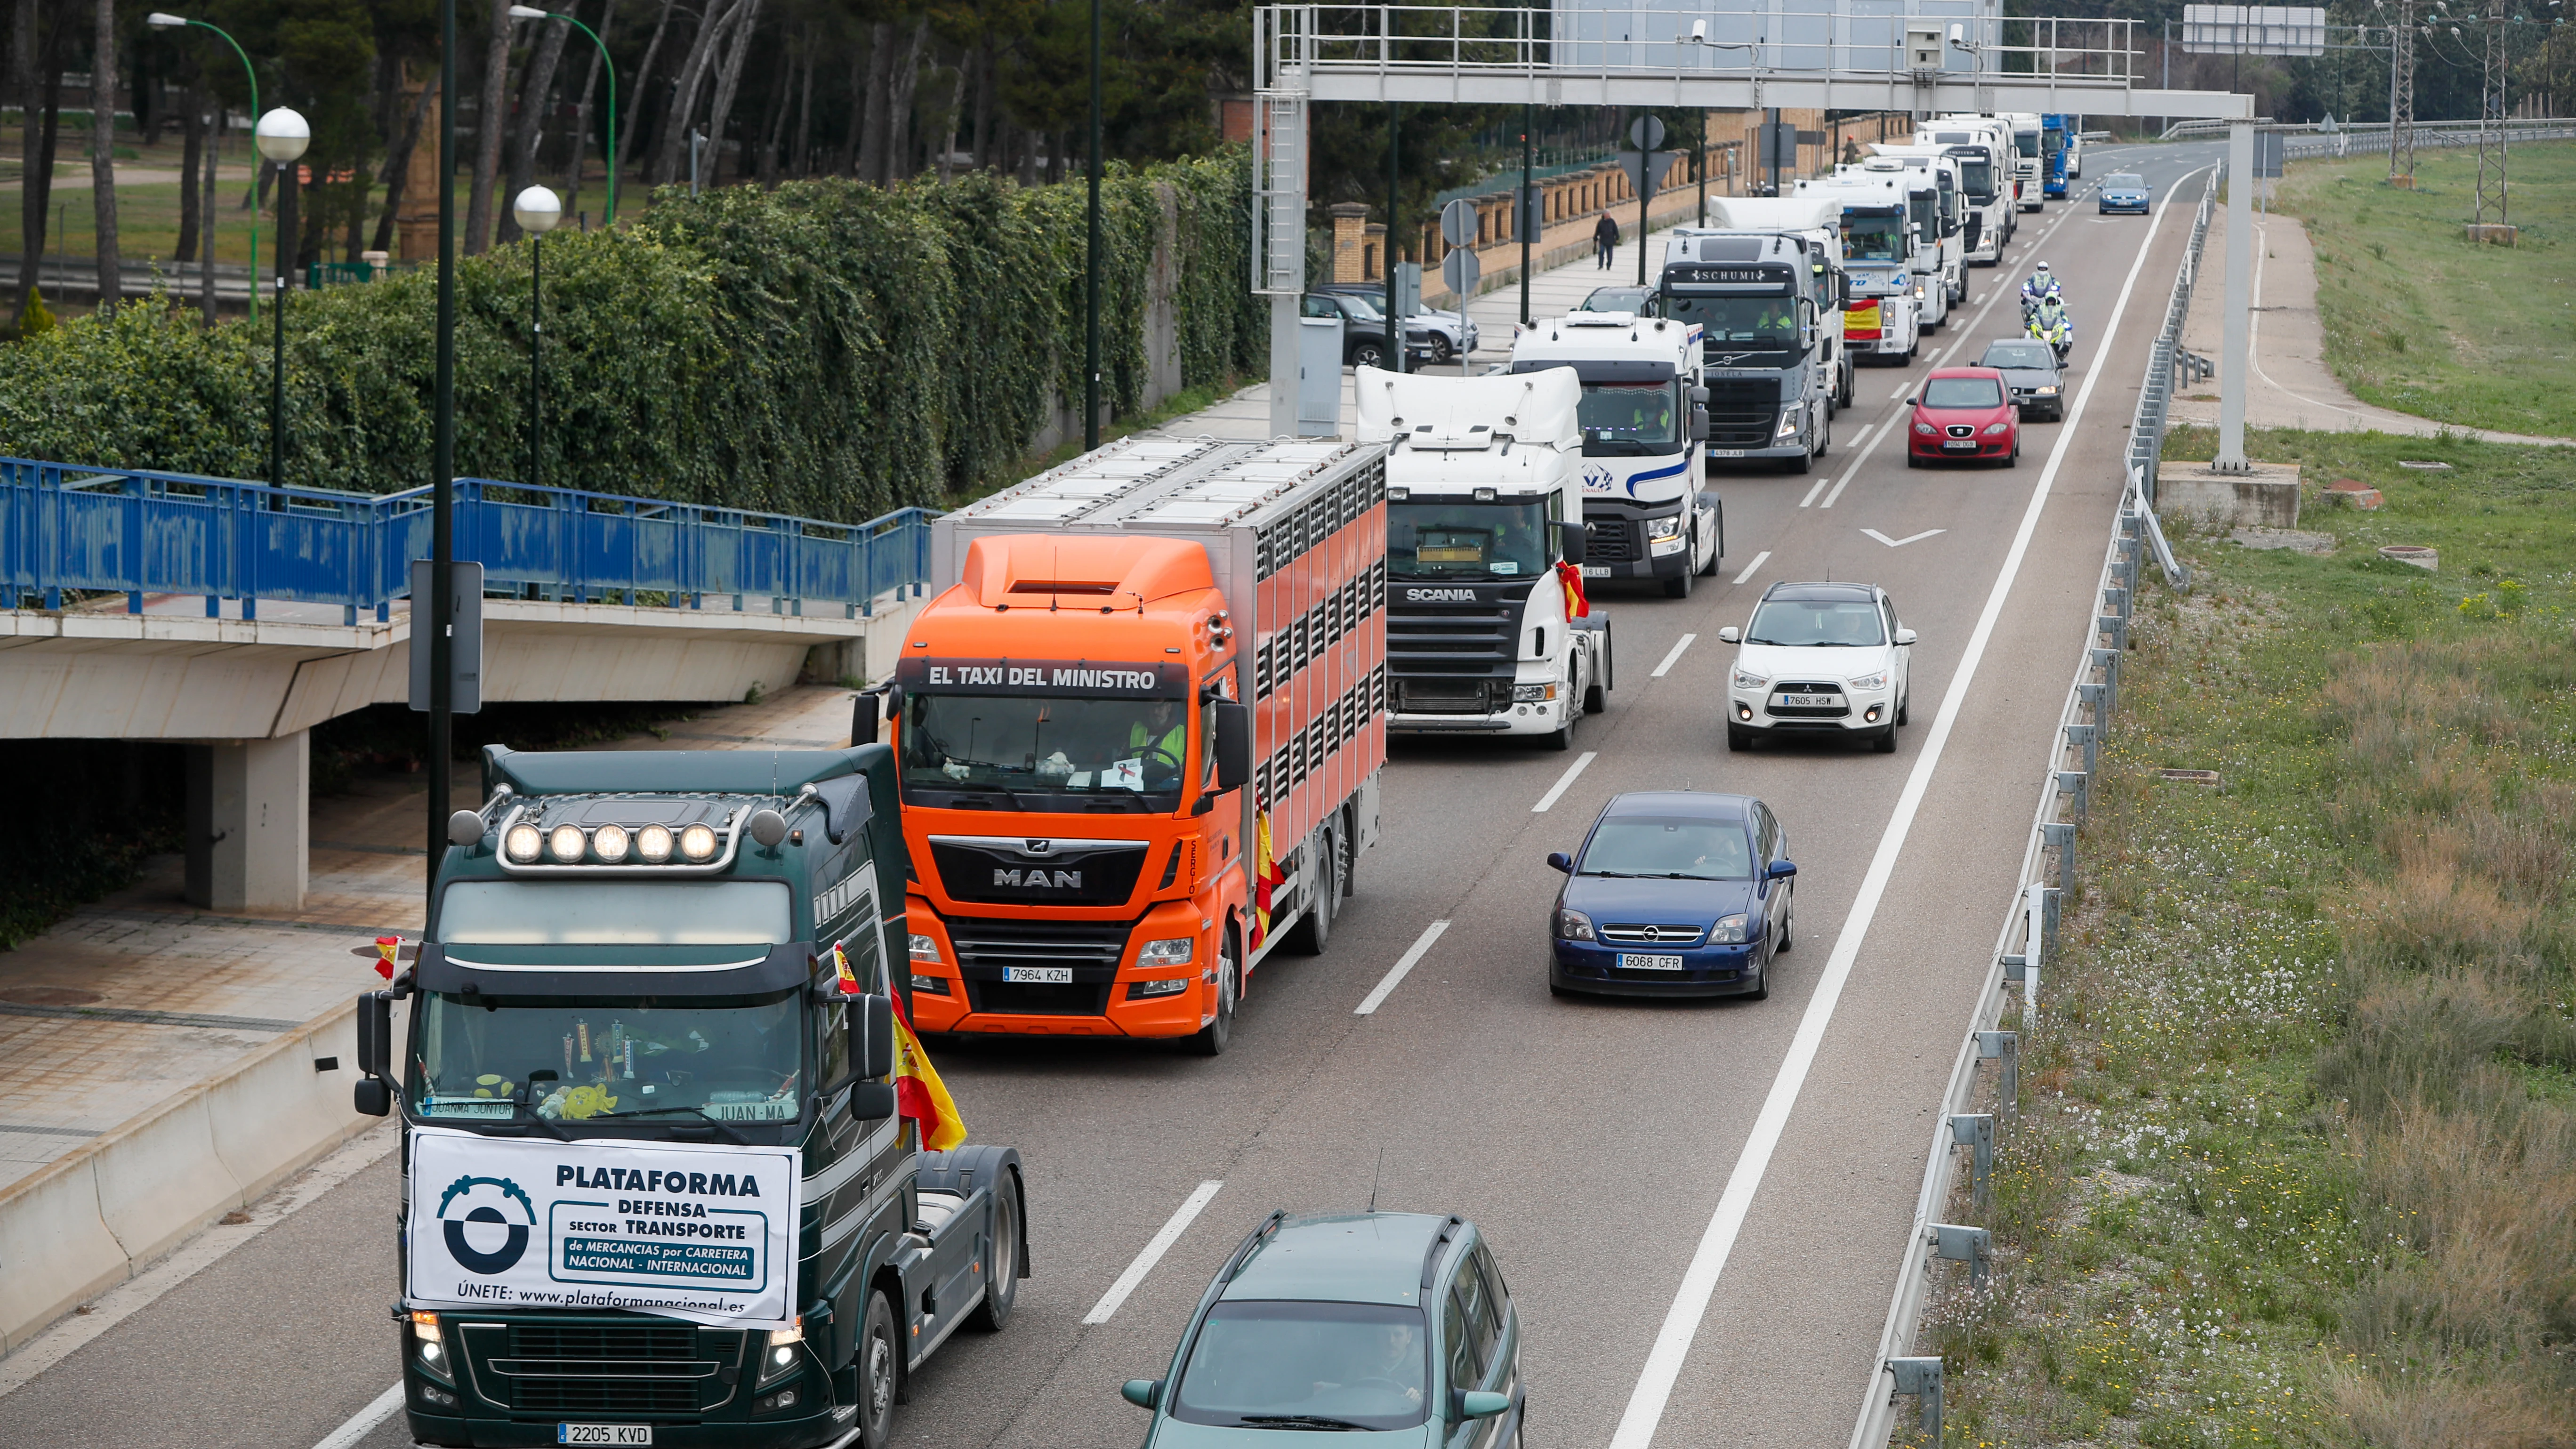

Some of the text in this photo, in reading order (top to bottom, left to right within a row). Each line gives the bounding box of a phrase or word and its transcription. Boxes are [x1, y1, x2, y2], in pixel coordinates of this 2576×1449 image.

[1702, 271, 1754, 280] SCHUMI
[1406, 588, 1477, 601] SCANIA
[929, 667, 1155, 690] EL TAXI DEL MINISTRO
[1790, 697, 1831, 705] 7605 HSW
[1188, 840, 1196, 894] SERGIO
[994, 869, 1081, 888] MAN
[1626, 956, 1679, 968] 6068 CFR
[1013, 969, 1041, 981] 7964
[1046, 970, 1068, 981] KZH
[716, 1105, 756, 1120] JUAN
[556, 1165, 760, 1197] PLATAFORMA
[618, 1199, 707, 1218] DEFENSA
[569, 1219, 746, 1240] SECTOR TRANSPORTE
[569, 1240, 749, 1261] de MERCANCIAS por CARRETERA
[569, 1255, 634, 1270] NACIONAL
[646, 1259, 747, 1276] INTERNACIONAL
[457, 1280, 746, 1313] ÚNETE: www.plataformanacional.es
[572, 1426, 611, 1442] 2205
[618, 1427, 648, 1443] KVD
